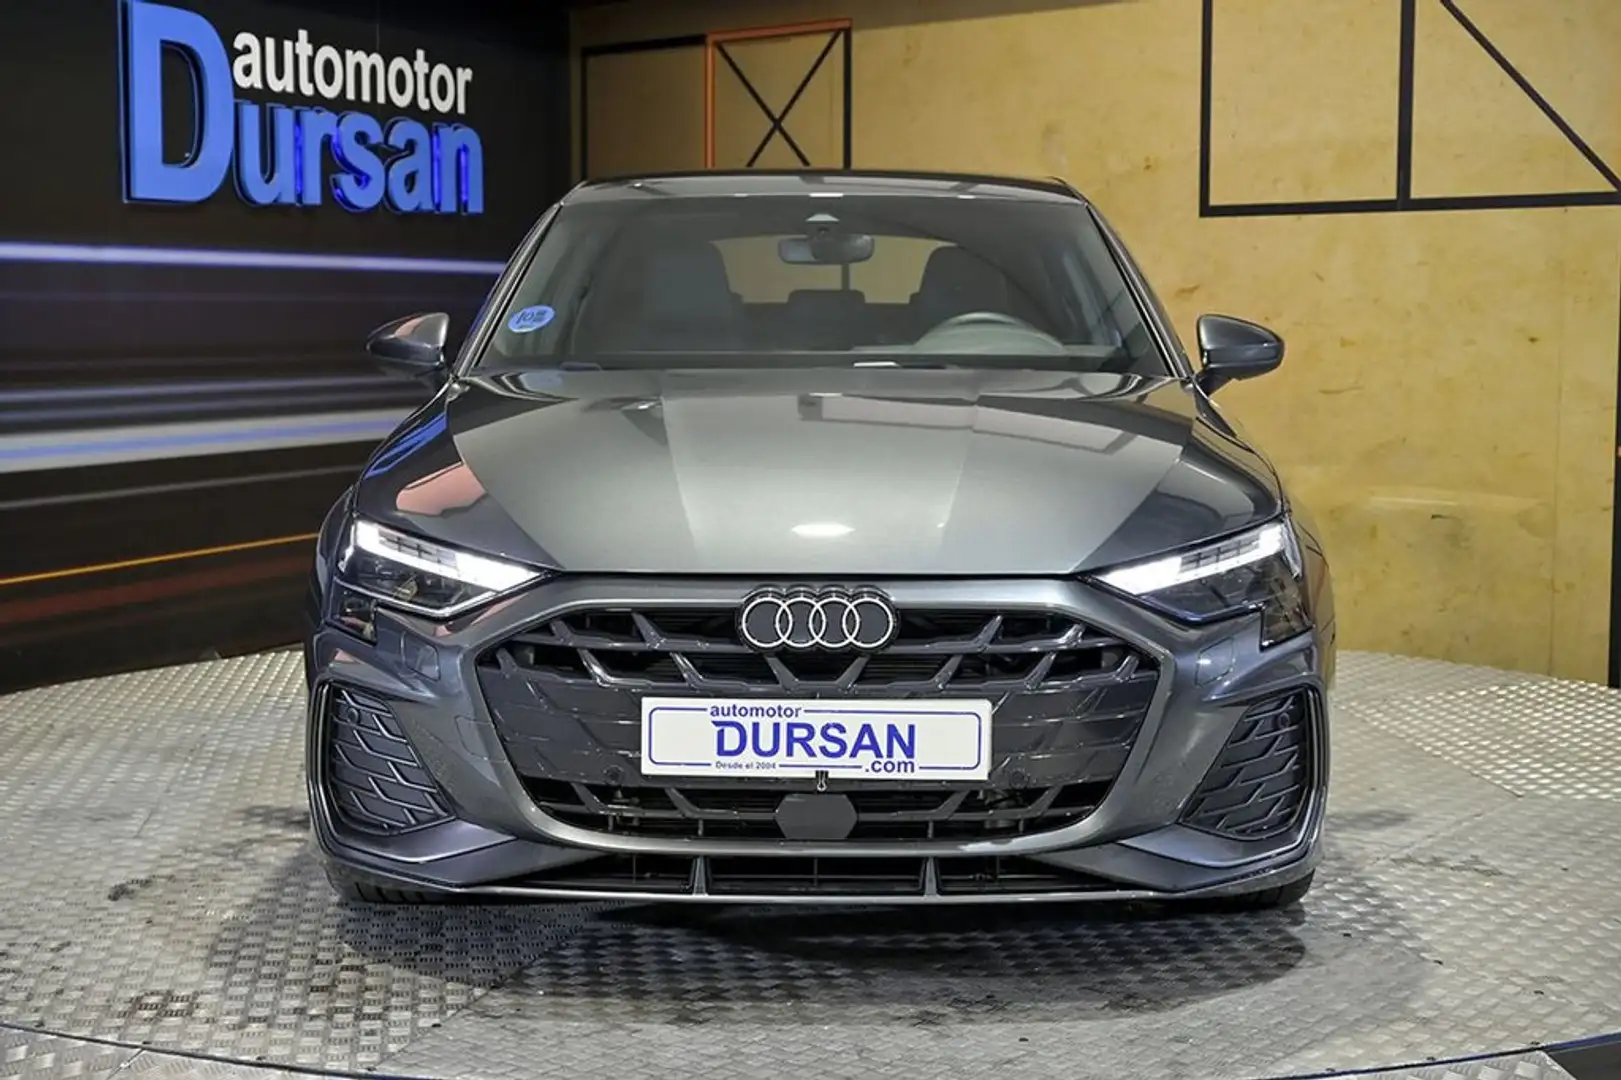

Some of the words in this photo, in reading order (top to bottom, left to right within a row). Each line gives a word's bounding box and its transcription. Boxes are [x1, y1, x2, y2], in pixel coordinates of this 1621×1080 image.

[233, 29, 473, 114] automotor
[118, 0, 484, 213] Dursan
[710, 704, 802, 718] automotor
[712, 720, 916, 759] DURSAN
[865, 758, 916, 774] .com
